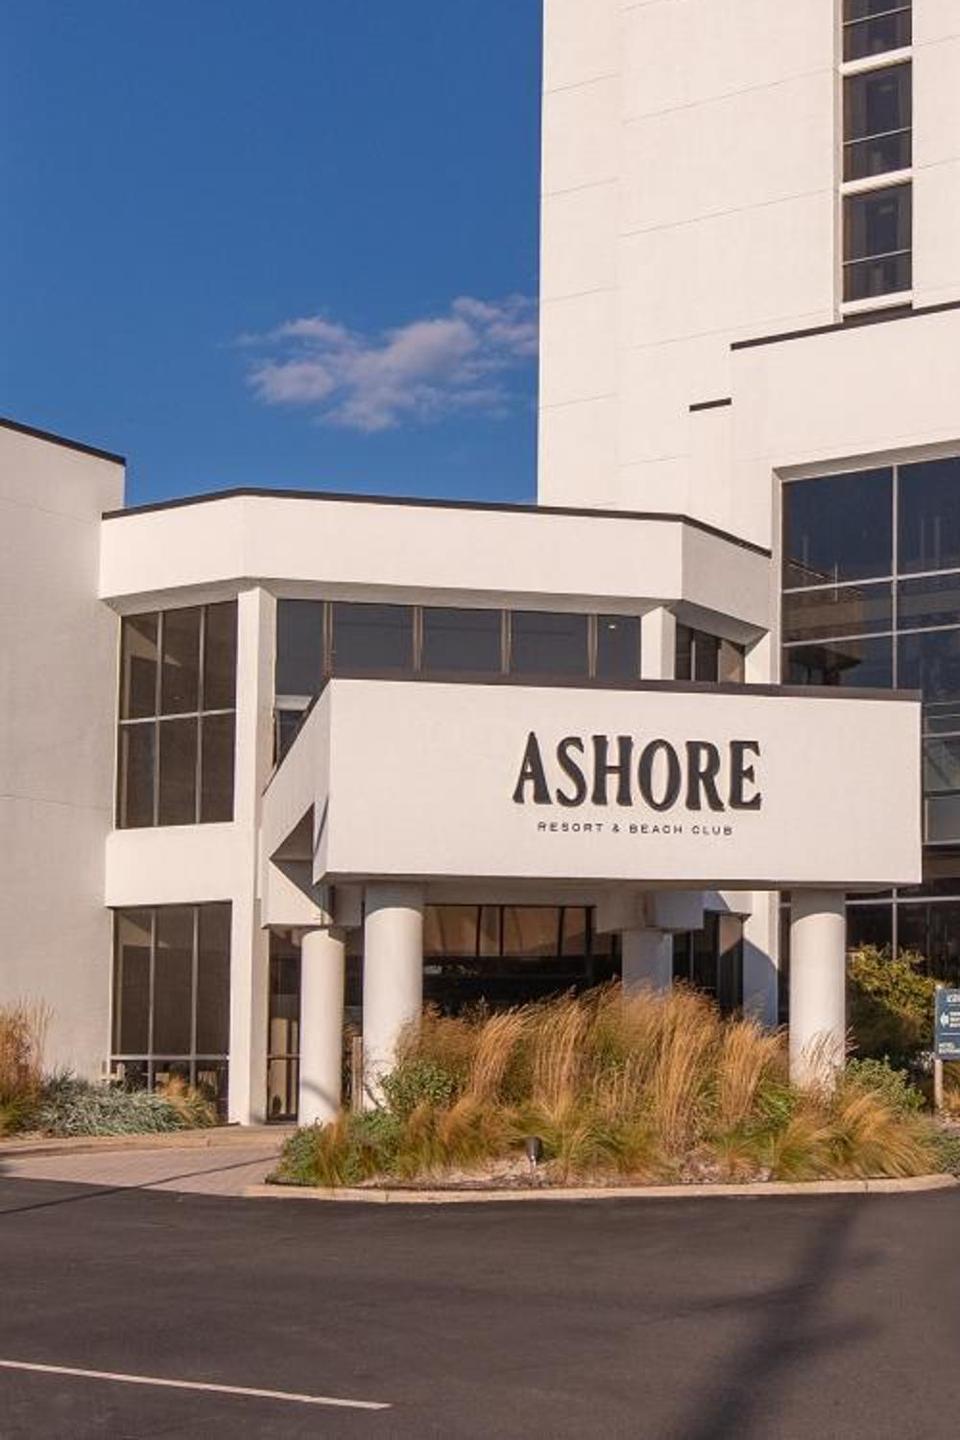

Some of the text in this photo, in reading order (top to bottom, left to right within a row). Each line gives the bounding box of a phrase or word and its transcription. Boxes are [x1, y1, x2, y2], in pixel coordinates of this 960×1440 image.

[512, 730, 763, 812] ASHORE
[537, 821, 733, 836] RESORT & BEACH CLUB
